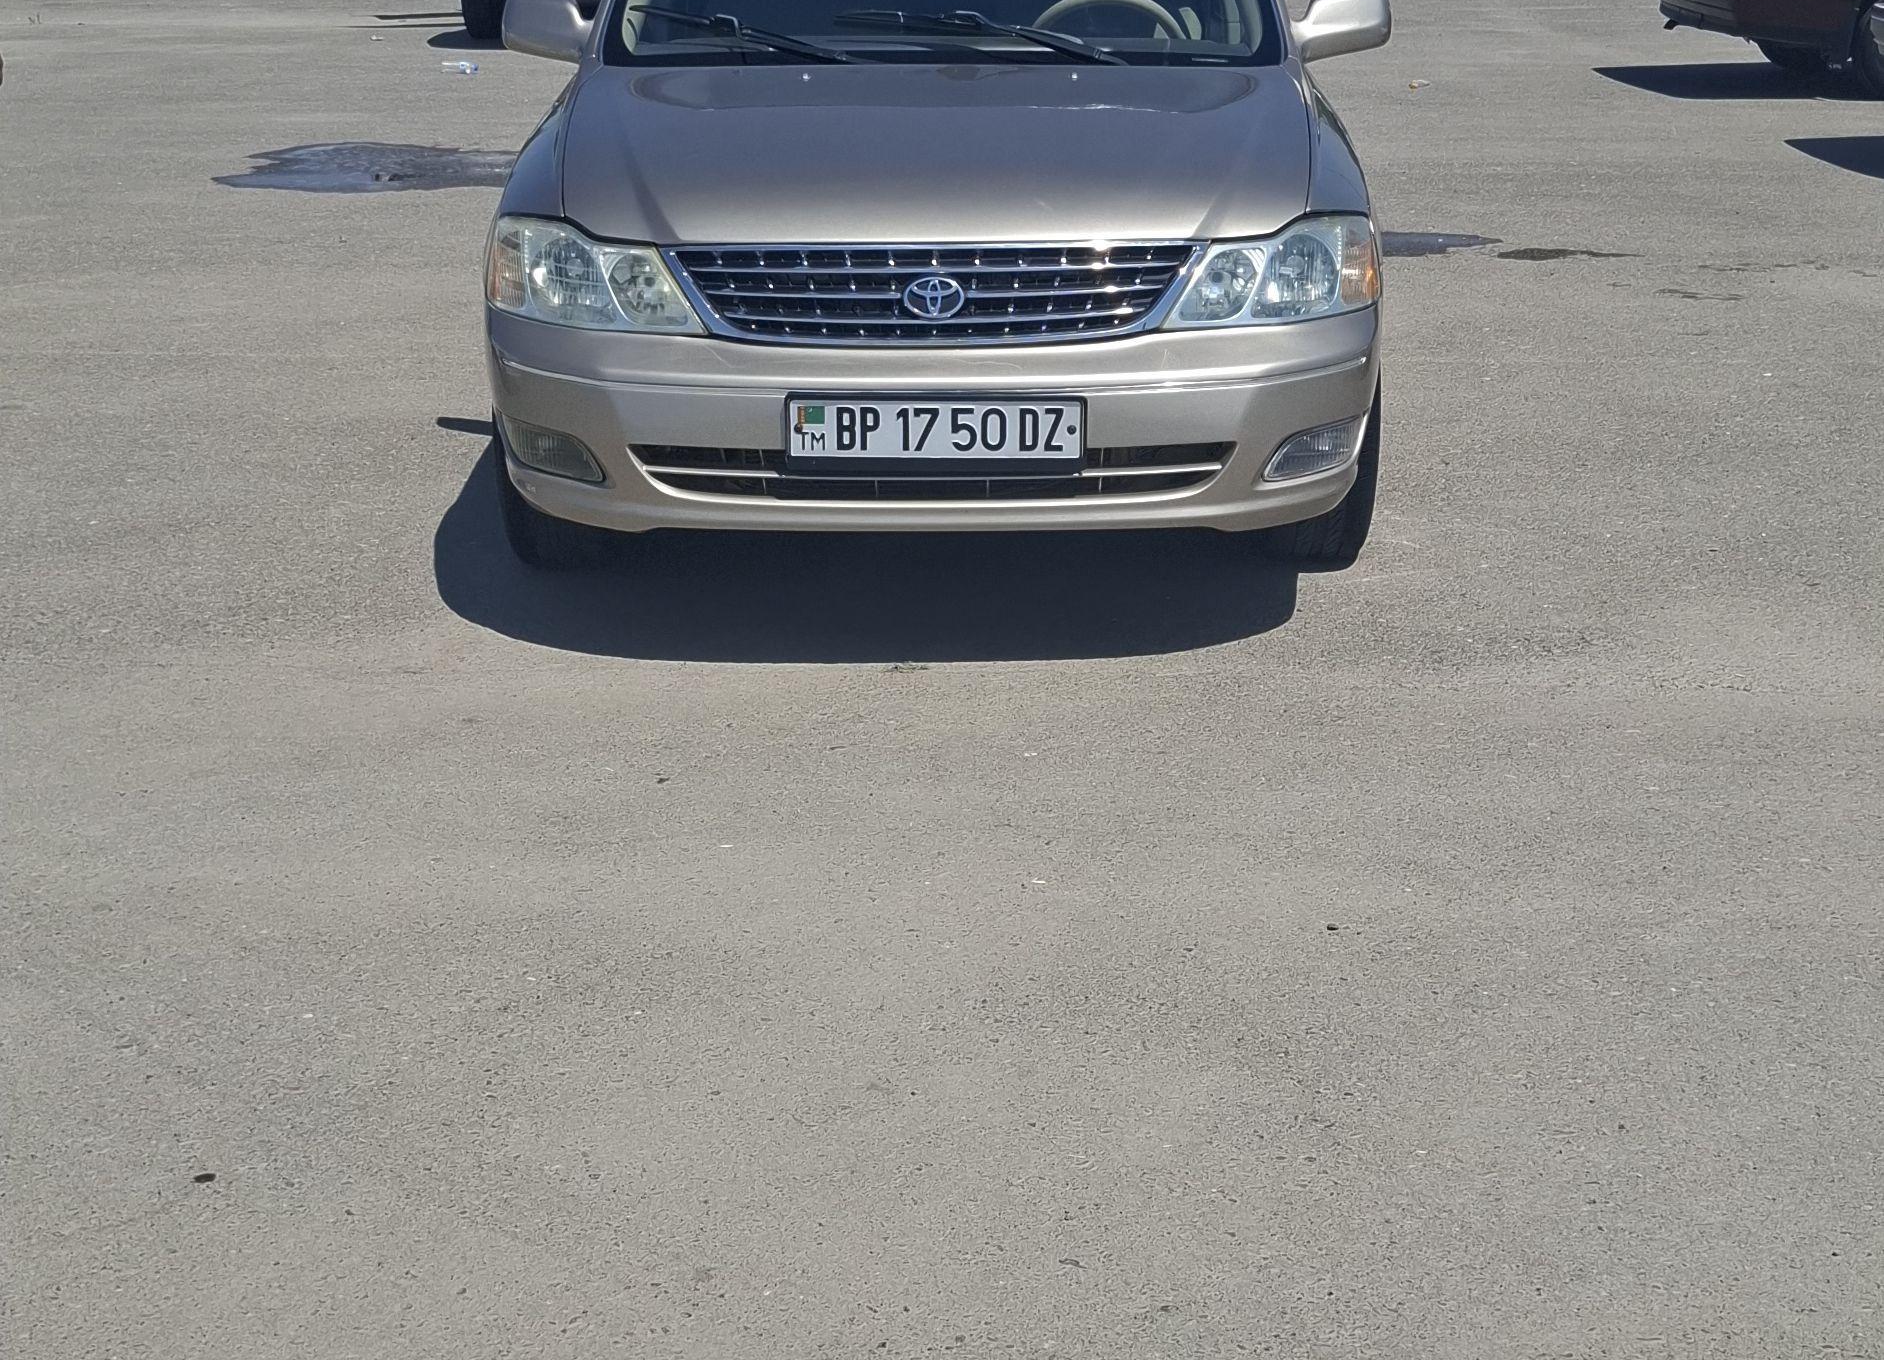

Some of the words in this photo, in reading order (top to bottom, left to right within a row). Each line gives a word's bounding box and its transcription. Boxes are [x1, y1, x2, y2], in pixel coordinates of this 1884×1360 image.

[799, 431, 826, 451] TM
[836, 406, 881, 451] BP
[896, 407, 940, 451] 17
[950, 407, 1007, 452] 50
[1019, 407, 1064, 452] DZ
